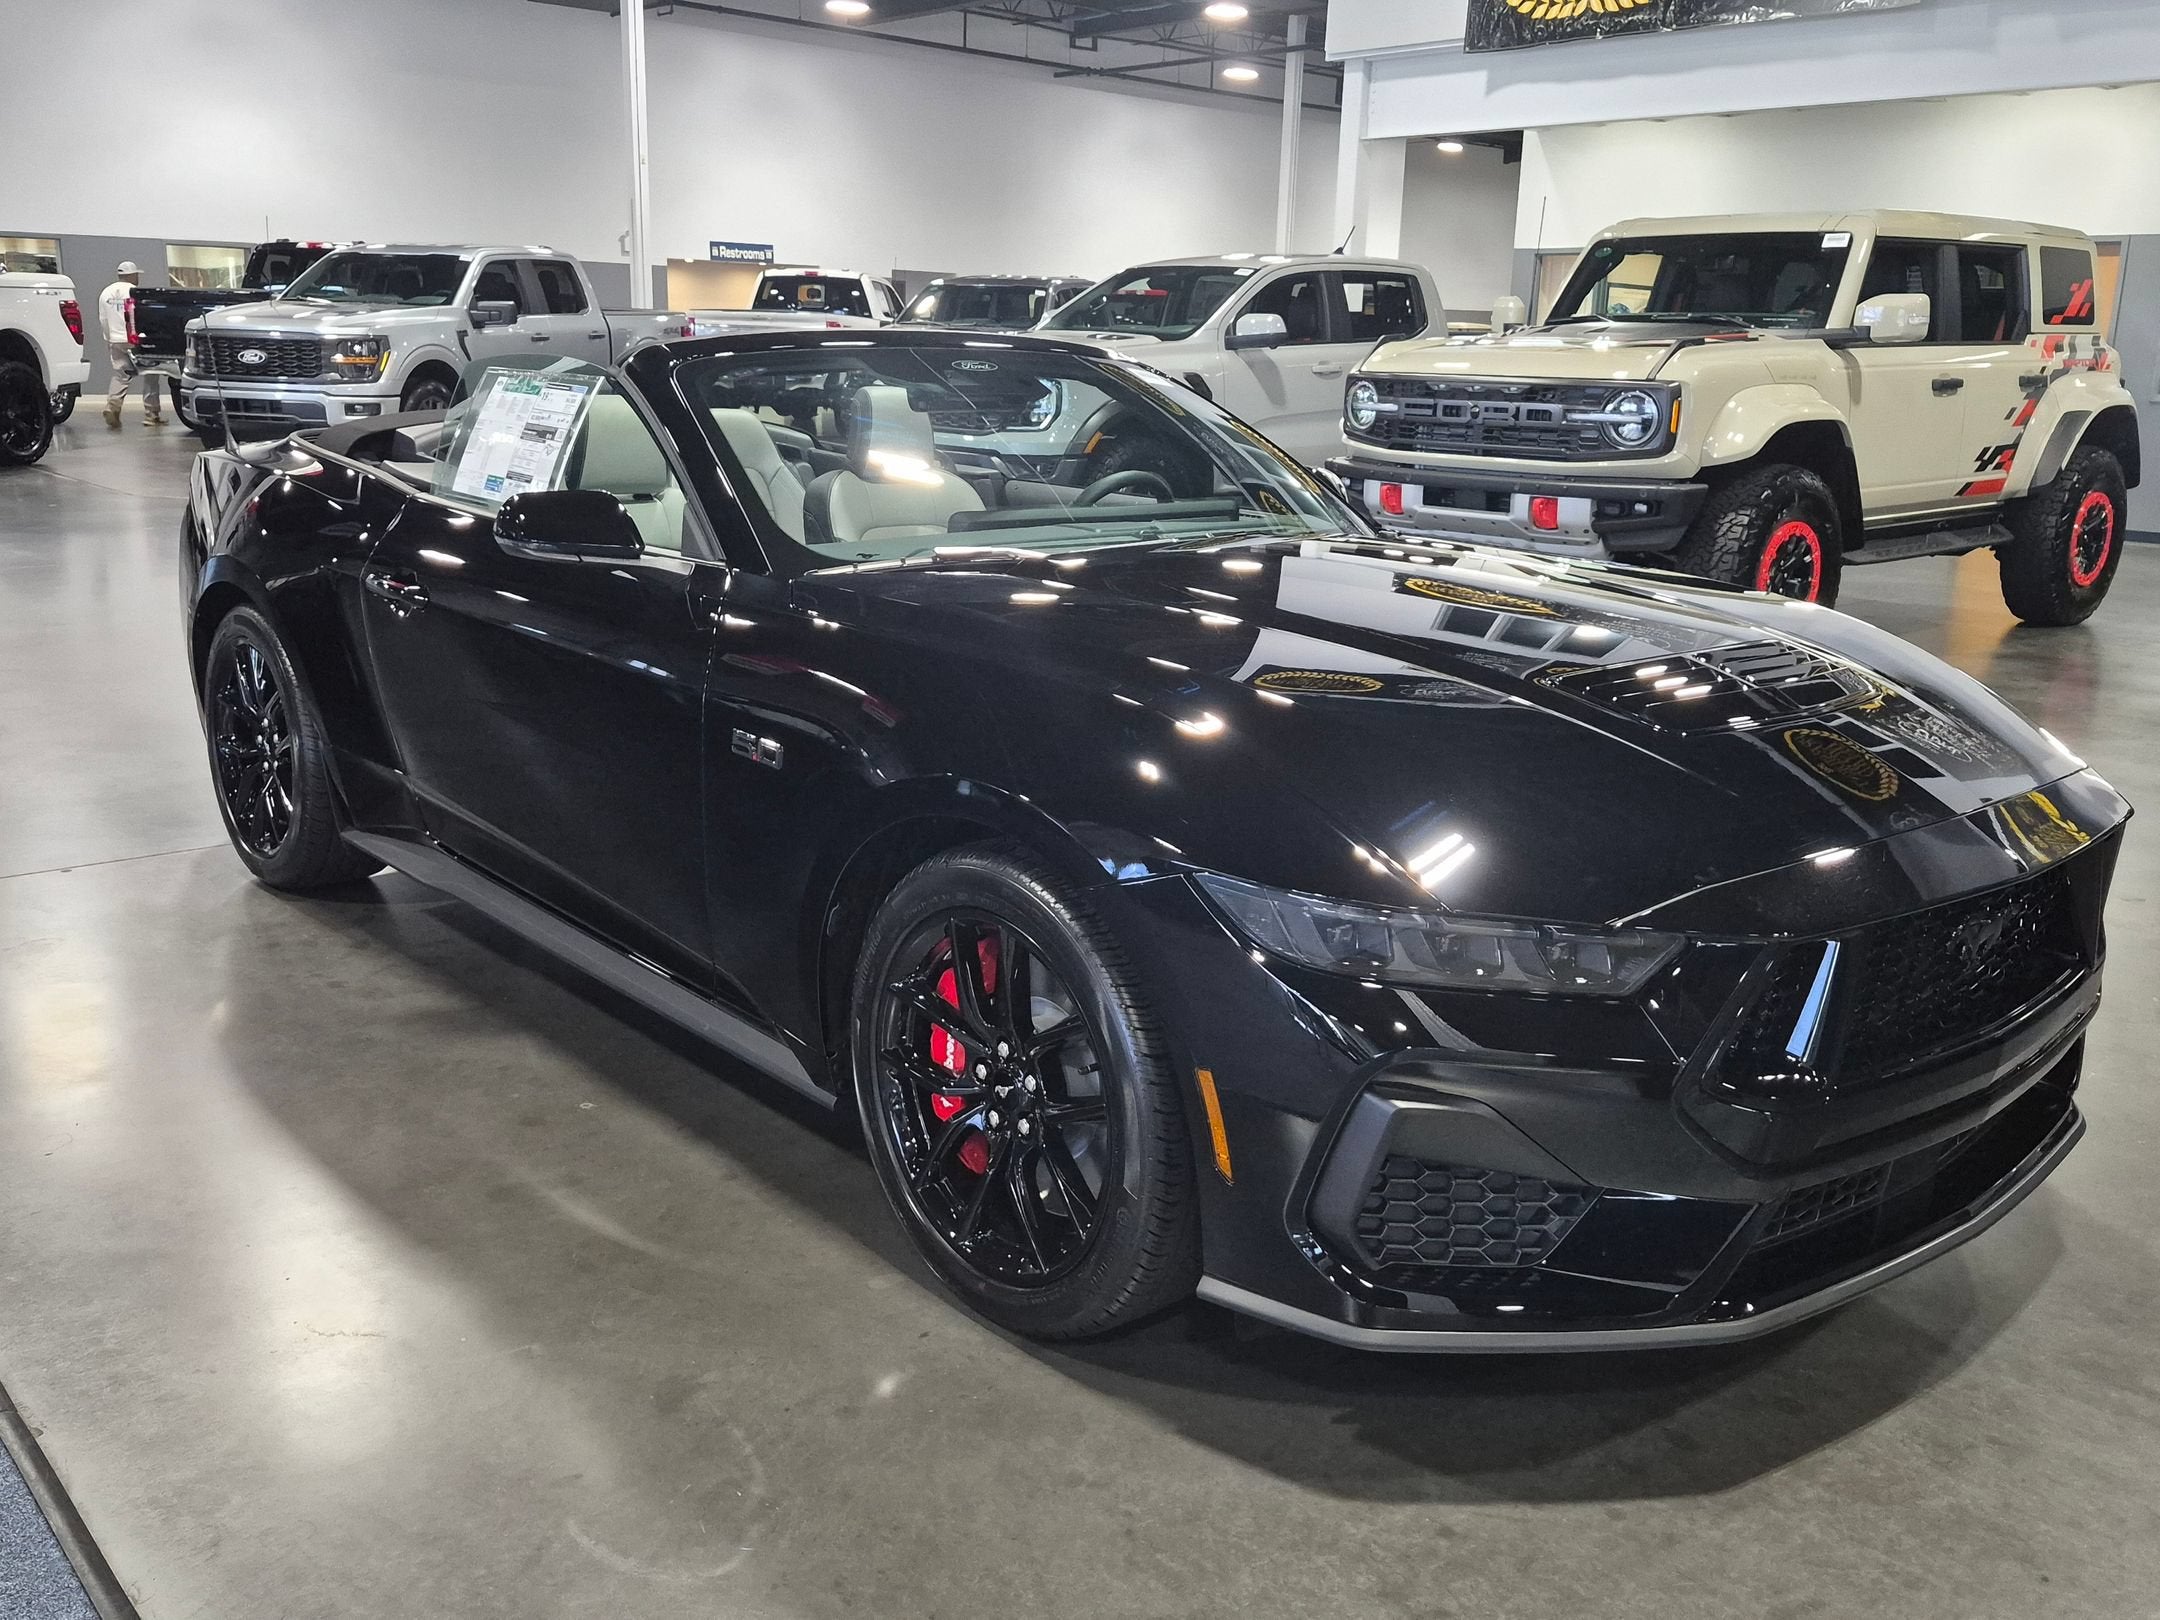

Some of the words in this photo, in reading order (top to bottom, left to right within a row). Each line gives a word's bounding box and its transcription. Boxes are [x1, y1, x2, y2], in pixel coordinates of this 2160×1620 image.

[719, 245, 765, 260] Restrooms
[240, 351, 262, 362] Ford
[958, 360, 991, 370] Ford
[1402, 398, 1563, 425] FORD
[732, 727, 783, 770] 5.0
[943, 1032, 955, 1070] bre
